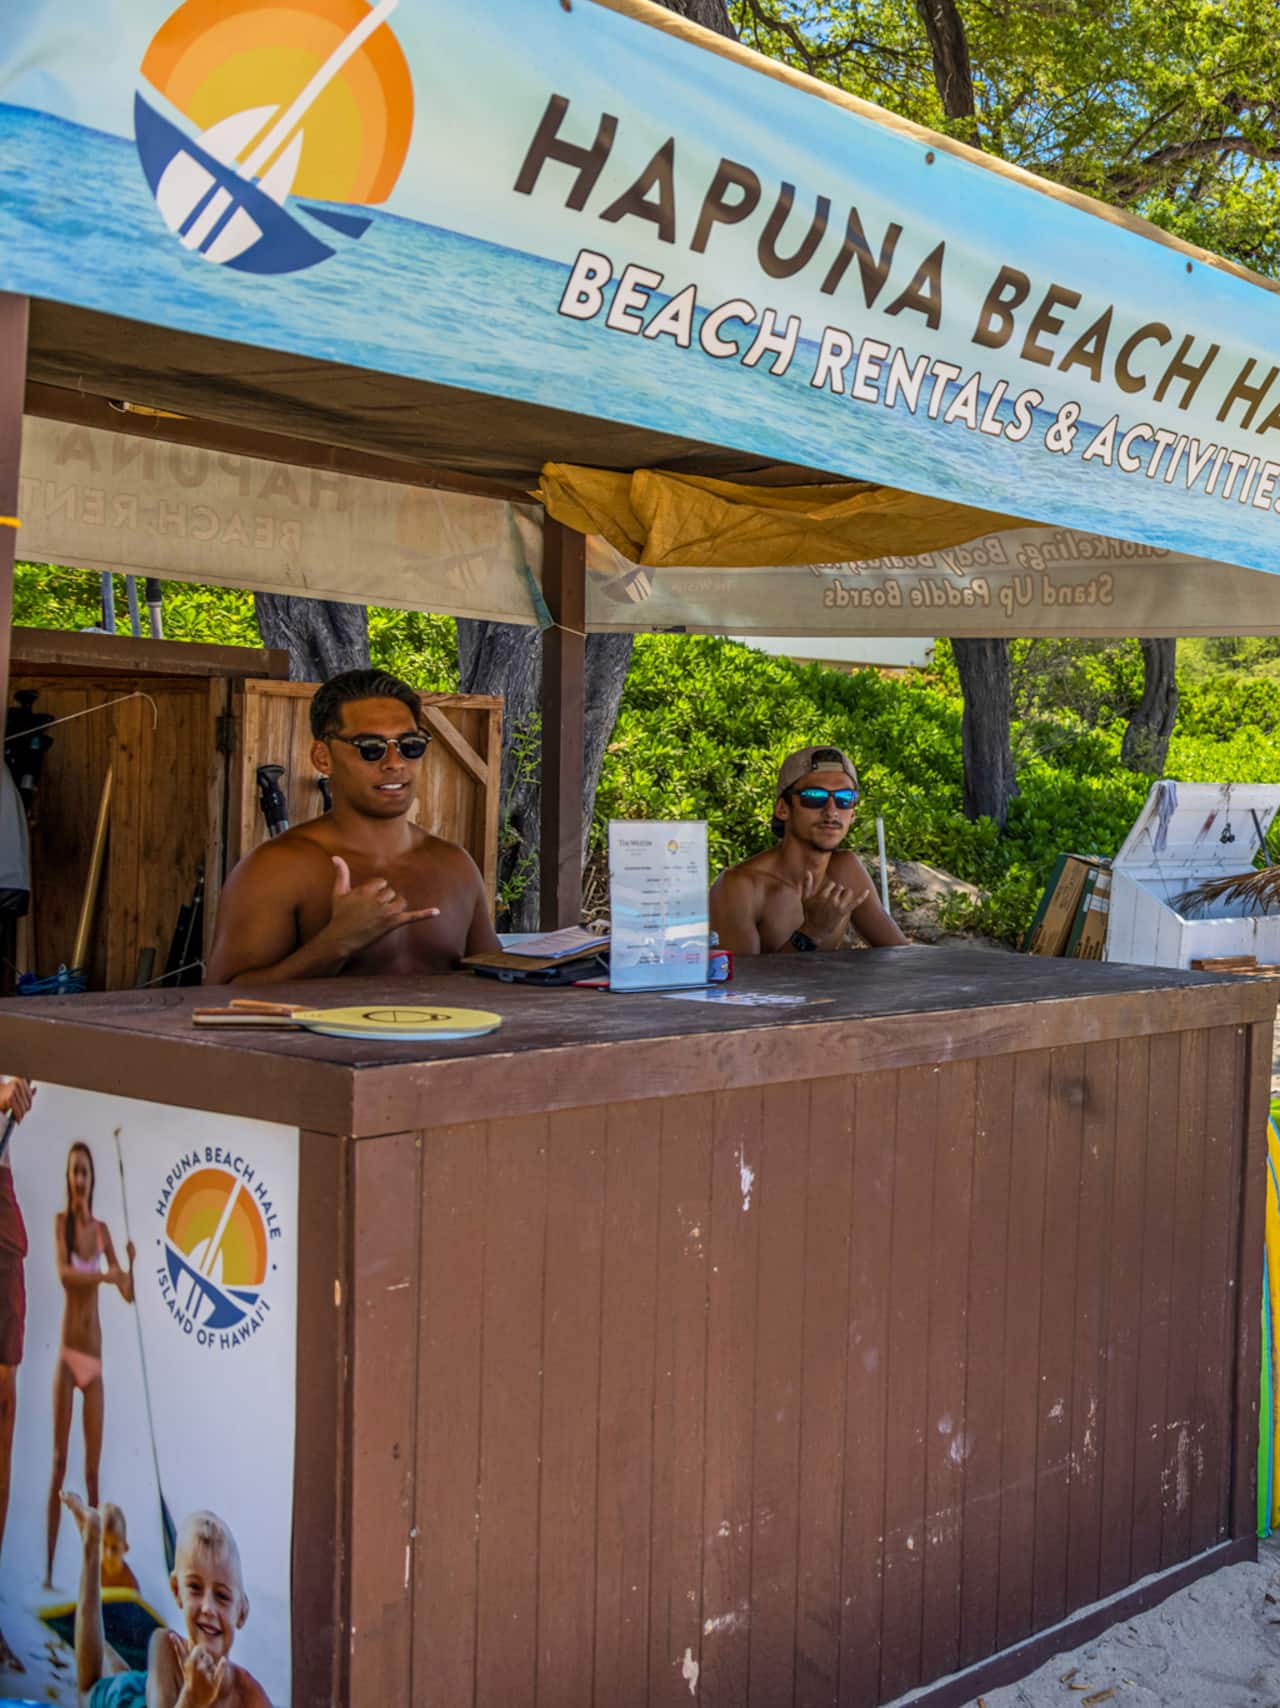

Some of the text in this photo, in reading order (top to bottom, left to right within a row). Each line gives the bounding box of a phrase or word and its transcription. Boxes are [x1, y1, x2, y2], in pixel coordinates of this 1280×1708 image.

[514, 94, 945, 330] HAPUNA
[971, 265, 1219, 410] BEACH
[558, 248, 802, 377] BEACH
[810, 326, 1045, 443] RENTALS
[1045, 401, 1081, 455] &
[155, 1147, 282, 1239] HAPUNA BEACH HALE
[156, 1267, 194, 1335] ISLAND
[196, 1328, 216, 1349] OF
